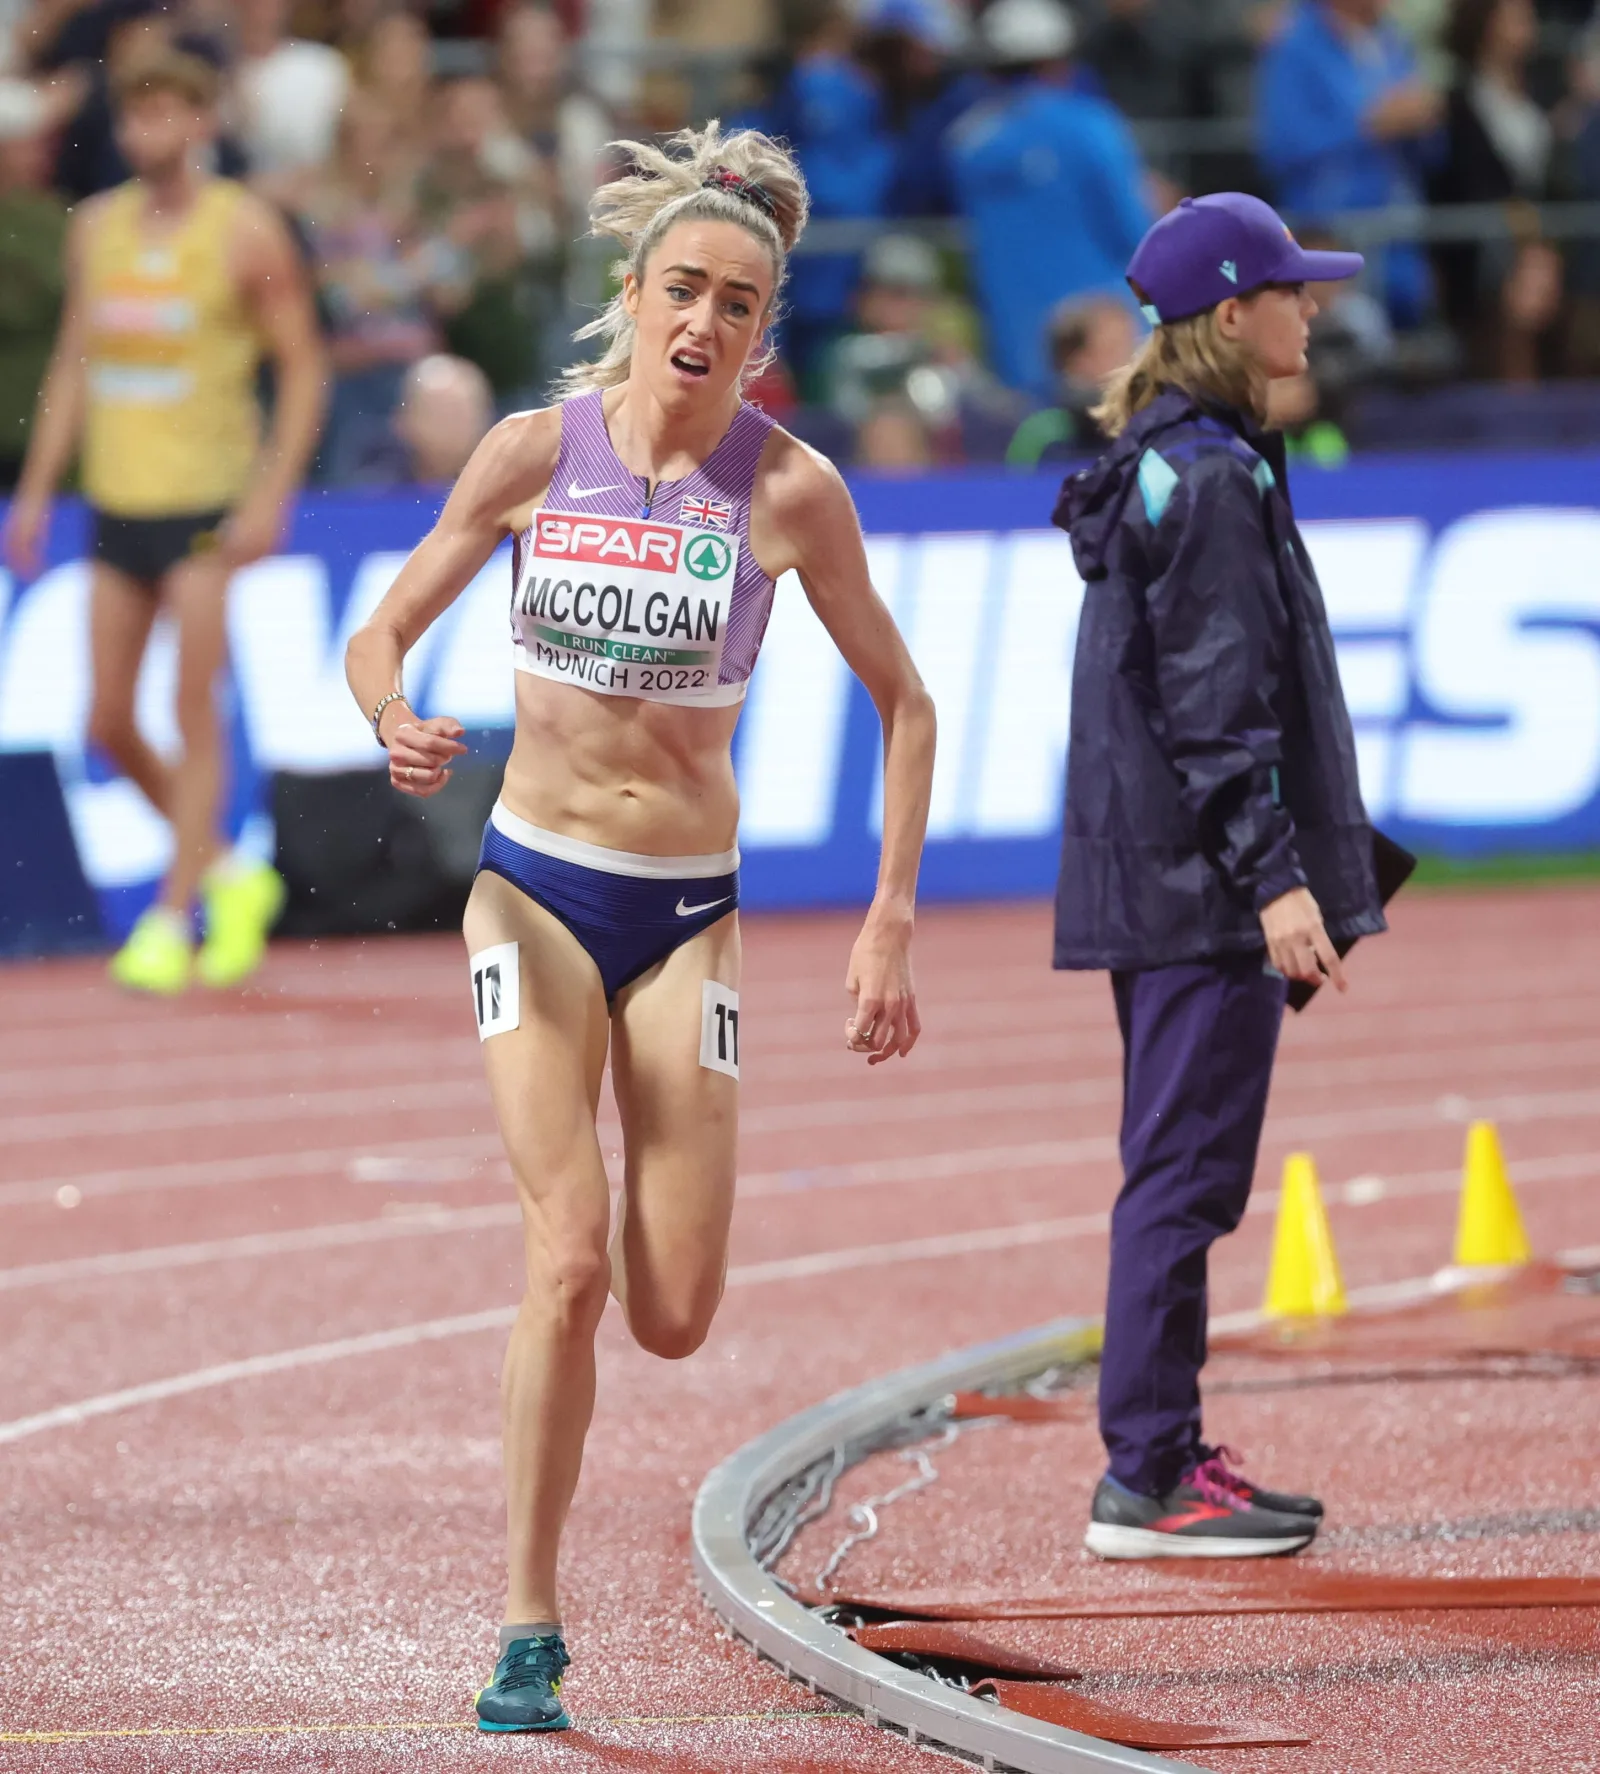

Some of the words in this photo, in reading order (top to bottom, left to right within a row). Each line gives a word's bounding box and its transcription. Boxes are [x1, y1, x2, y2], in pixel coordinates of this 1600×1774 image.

[538, 519, 677, 567] SPAR
[521, 576, 720, 642] MCCOLGAN
[536, 642, 629, 689] MUNICH
[639, 670, 706, 691] 2022
[563, 634, 567, 645] I
[572, 635, 607, 655] RUN
[474, 963, 501, 1027] 11
[715, 1003, 739, 1066] 11
